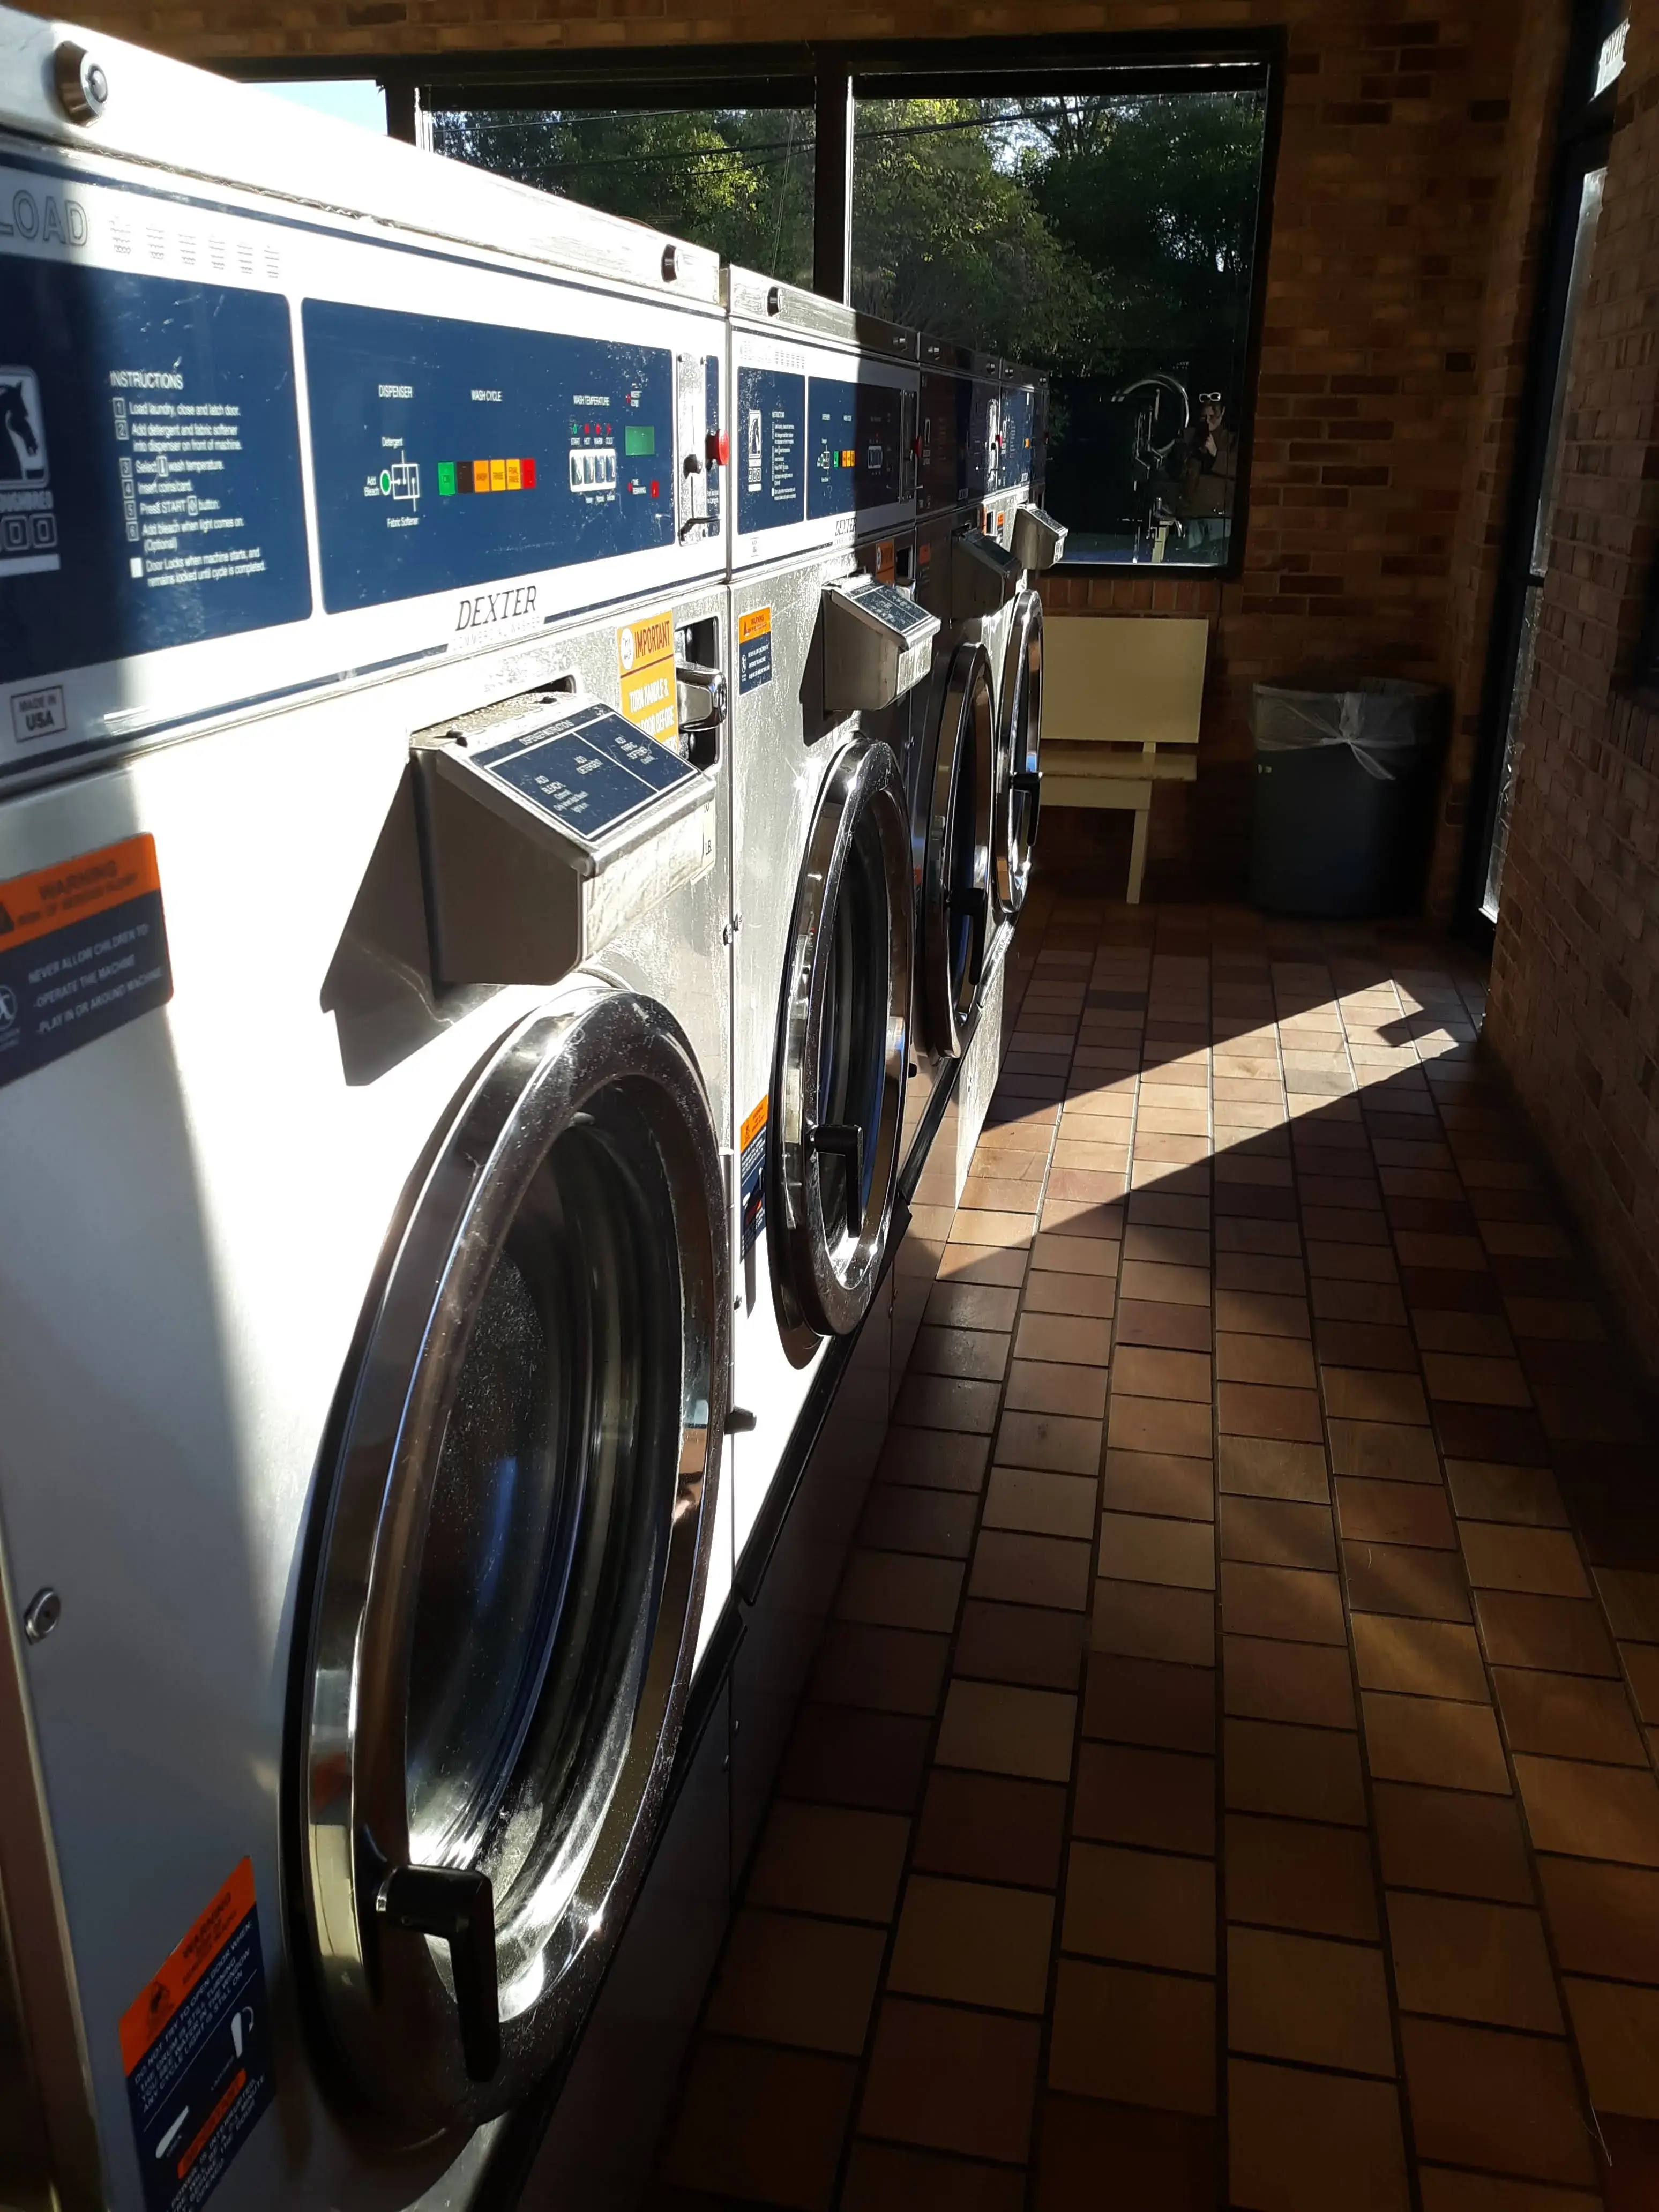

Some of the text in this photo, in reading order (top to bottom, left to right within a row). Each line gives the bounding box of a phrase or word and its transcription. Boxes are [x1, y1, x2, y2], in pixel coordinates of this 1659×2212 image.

[109, 371, 184, 390] INSTRUCTIONS
[378, 384, 415, 399] DISPENSER
[470, 390, 503, 402] WASH CYCLE
[573, 395, 584, 405] WASH
[129, 401, 149, 415] Load
[149, 403, 177, 418] laundry,
[177, 403, 195, 416] close
[196, 403, 208, 416] and
[209, 404, 224, 416] latch
[132, 423, 147, 436] Add
[147, 423, 181, 439] detergent
[181, 424, 194, 435] and
[194, 424, 212, 436] fabric
[213, 423, 238, 436] softener
[133, 440, 147, 452] into
[148, 439, 181, 454] dispenser
[182, 442, 191, 451] on
[191, 439, 207, 451] front
[207, 439, 214, 450] of
[382, 437, 403, 448] Detergent
[594, 437, 603, 445] WARM
[135, 459, 158, 474] Select
[168, 459, 185, 472] wash
[138, 482, 158, 495] Insert
[367, 475, 377, 485] Add
[364, 485, 379, 496] Bleach
[140, 502, 162, 515] Press
[162, 499, 186, 514] START
[142, 524, 158, 536] Add
[158, 519, 181, 535] bleach
[181, 521, 199, 532] when
[199, 518, 213, 533] light
[214, 518, 234, 529] comes
[386, 515, 419, 528] Fabric Softener
[144, 536, 178, 555] (Optional)
[146, 559, 163, 573] Door
[163, 558, 185, 570] Locks
[185, 555, 203, 567] when
[203, 552, 229, 565] machine
[248, 547, 261, 558] and
[147, 574, 176, 588] remains
[176, 570, 198, 584] locked
[198, 569, 212, 580] until
[212, 566, 228, 581] cycle
[228, 566, 234, 576] is
[455, 585, 537, 631] DEXTER
[634, 620, 670, 659] IMPORTANT
[629, 677, 669, 713] TURN HANDLE &
[19, 697, 46, 712] MADE
[25, 710, 55, 731] USA
[655, 705, 675, 733] BEFORE
[519, 720, 574, 745] DISPENSER INSTRUCTIONS
[573, 755, 588, 764] ADD
[627, 747, 649, 759] SOFTENER
[576, 759, 604, 774] DETERGENT
[534, 775, 550, 784] ADD
[39, 861, 116, 900] WARNING
[28, 961, 60, 984] NEVER
[61, 947, 93, 970] ALLOW
[94, 929, 135, 956] CHILDREN
[79, 971, 97, 989] THE
[98, 954, 135, 980] MACHINE
[64, 1007, 74, 1022] IN
[74, 999, 89, 1017] OR
[90, 984, 125, 1010] AROUND
[182, 1890, 231, 1960] WARNING
[134, 2062, 147, 2085] DO
[147, 2041, 163, 2067] NOT
[165, 2020, 178, 2043] TRY
[180, 2004, 189, 2022] TO
[190, 1976, 210, 2008] OPEN
[210, 1947, 230, 1979] DOOR
[156, 2036, 177, 2071] DRUM
[178, 2025, 185, 2040] IS
[186, 1999, 204, 2028] STILL
[206, 1955, 236, 2001] TURNING
[141, 1947, 250, 2103] YOU SEE WATER IN THE WINDOW
[143, 1967, 242, 2114] ANY CYCLE LIGHT IS STILL ON
